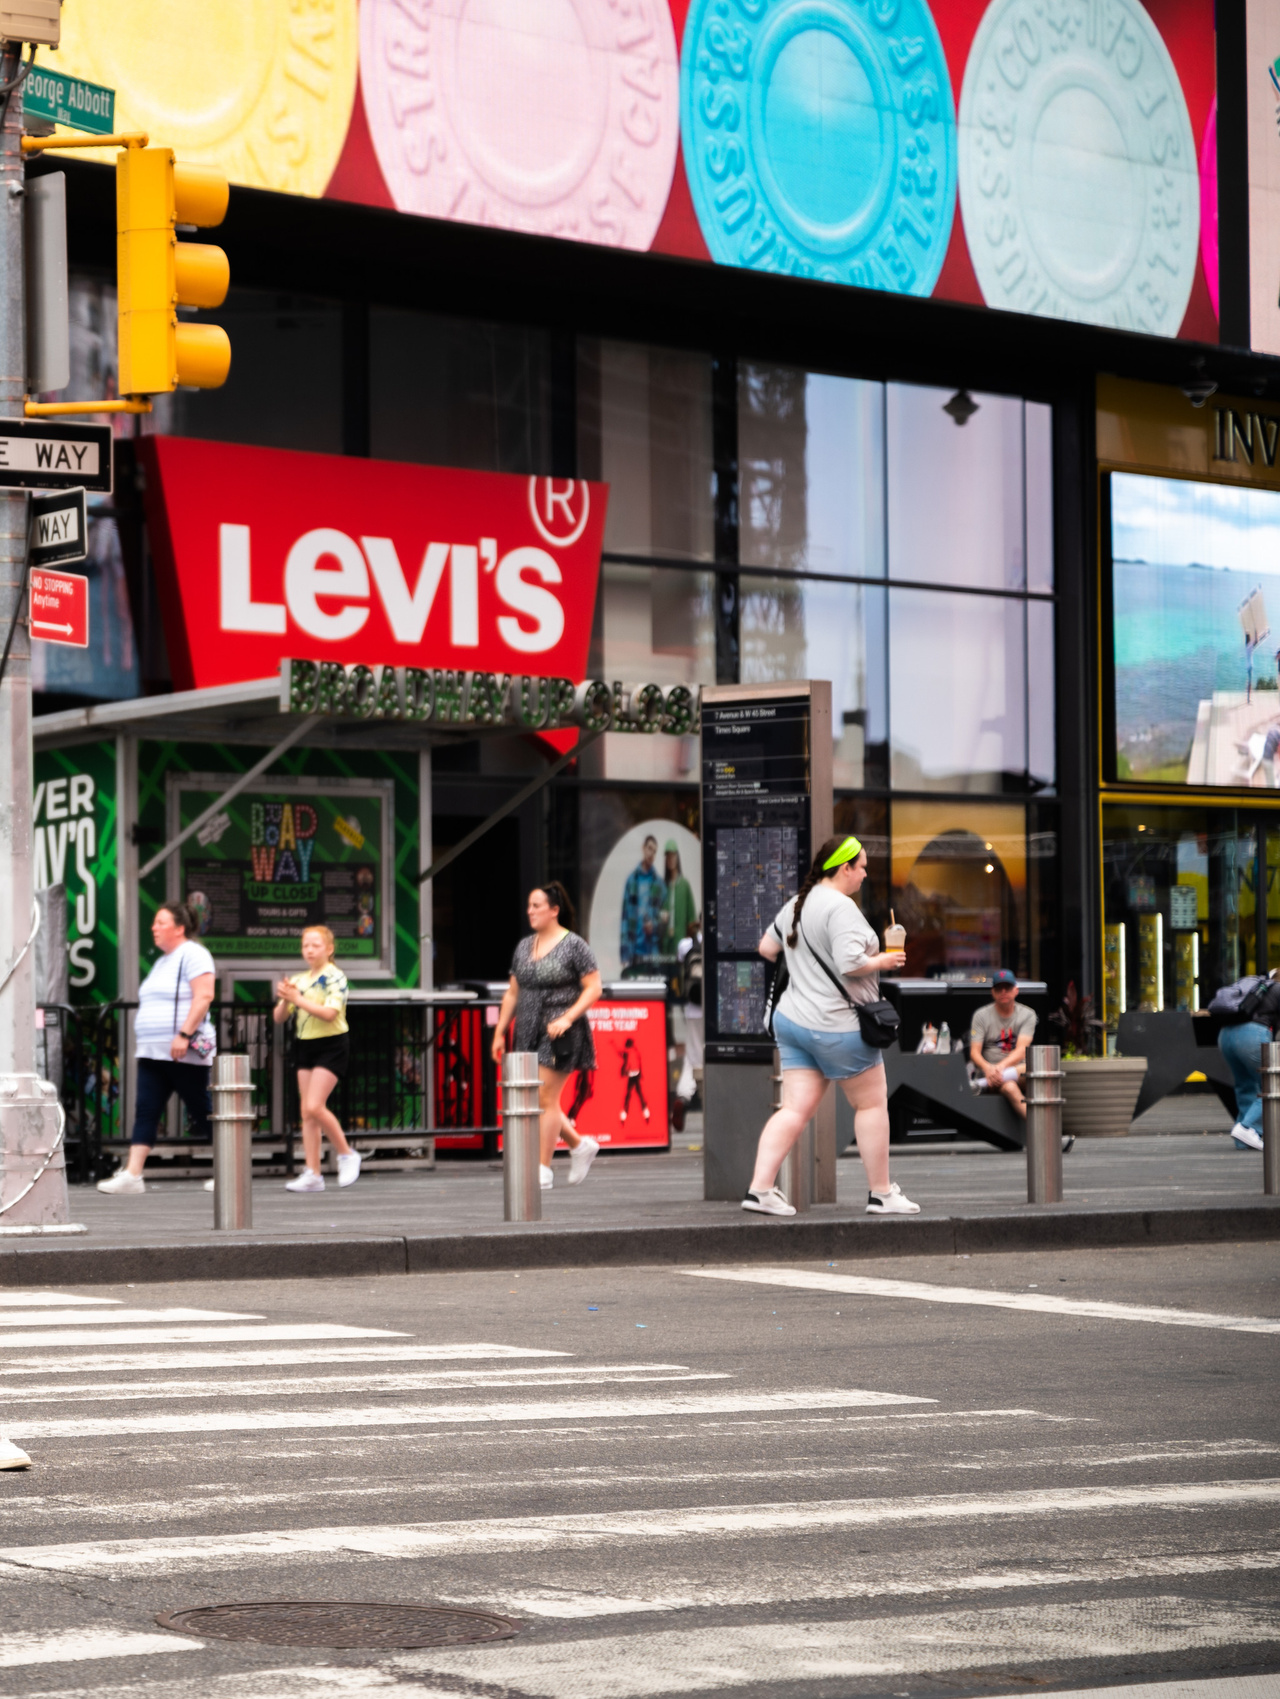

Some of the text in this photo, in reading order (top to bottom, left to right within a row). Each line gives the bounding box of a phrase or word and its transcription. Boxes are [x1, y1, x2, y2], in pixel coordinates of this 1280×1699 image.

[68, 82, 110, 118] Abbott
[57, 107, 71, 124] Way
[34, 442, 88, 471] WAY
[38, 512, 71, 544] WAY
[33, 576, 74, 596] NO STOPPING
[33, 592, 60, 609] Anytime
[281, 657, 701, 736] BROADWAY UP CLOS
[719, 710, 739, 720] Avenue
[760, 708, 776, 717] Street
[715, 724, 751, 735] Times Square
[250, 886, 315, 899] UP CLOSE
